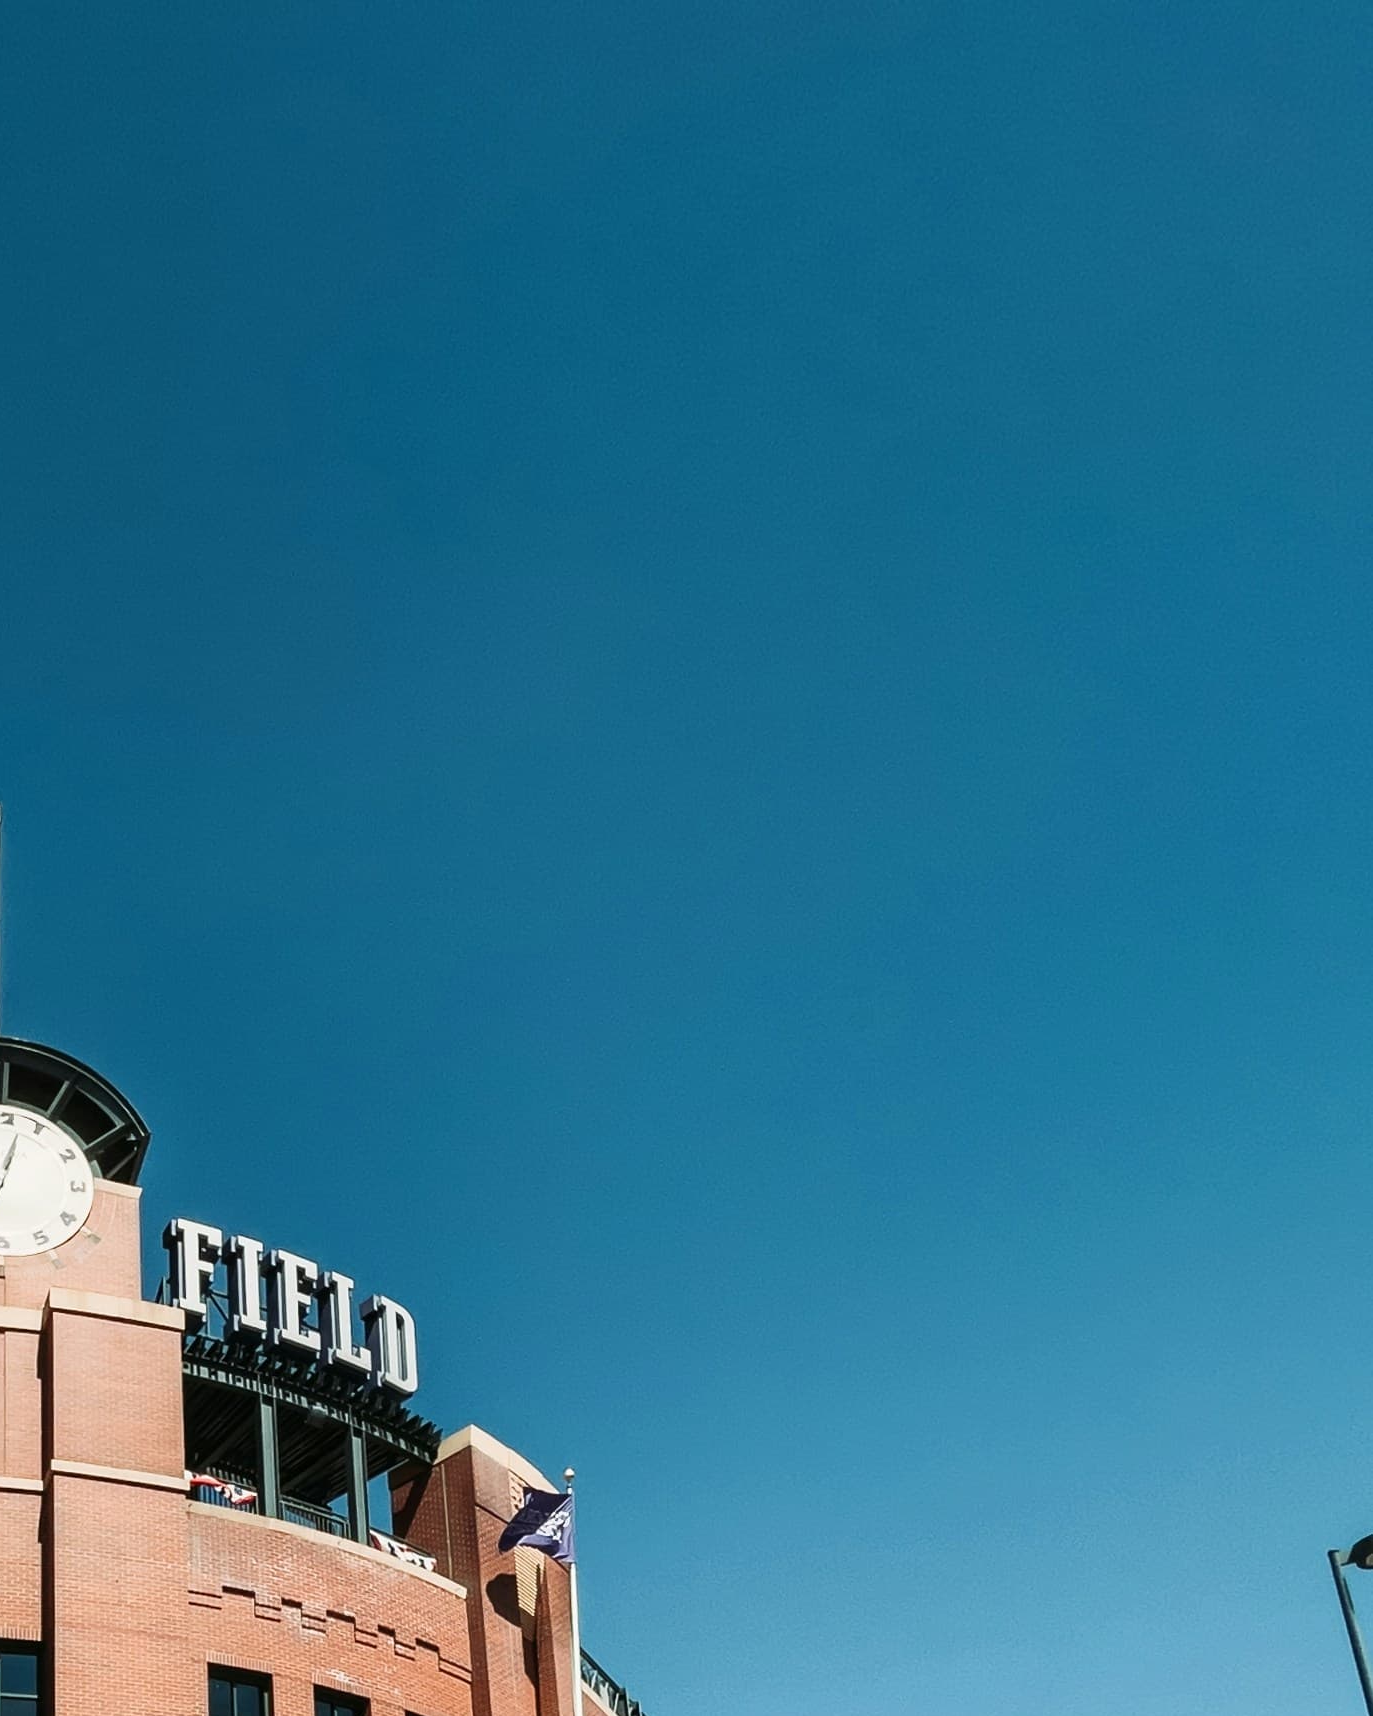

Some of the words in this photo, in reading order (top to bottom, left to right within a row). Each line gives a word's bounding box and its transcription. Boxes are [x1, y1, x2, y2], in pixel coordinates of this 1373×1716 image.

[34, 1121, 47, 1136] 1
[59, 1148, 77, 1164] 2
[70, 1180, 86, 1193] 3
[59, 1211, 77, 1227] 4
[32, 1230, 50, 1246] 5
[163, 1217, 419, 1396] FIELD
